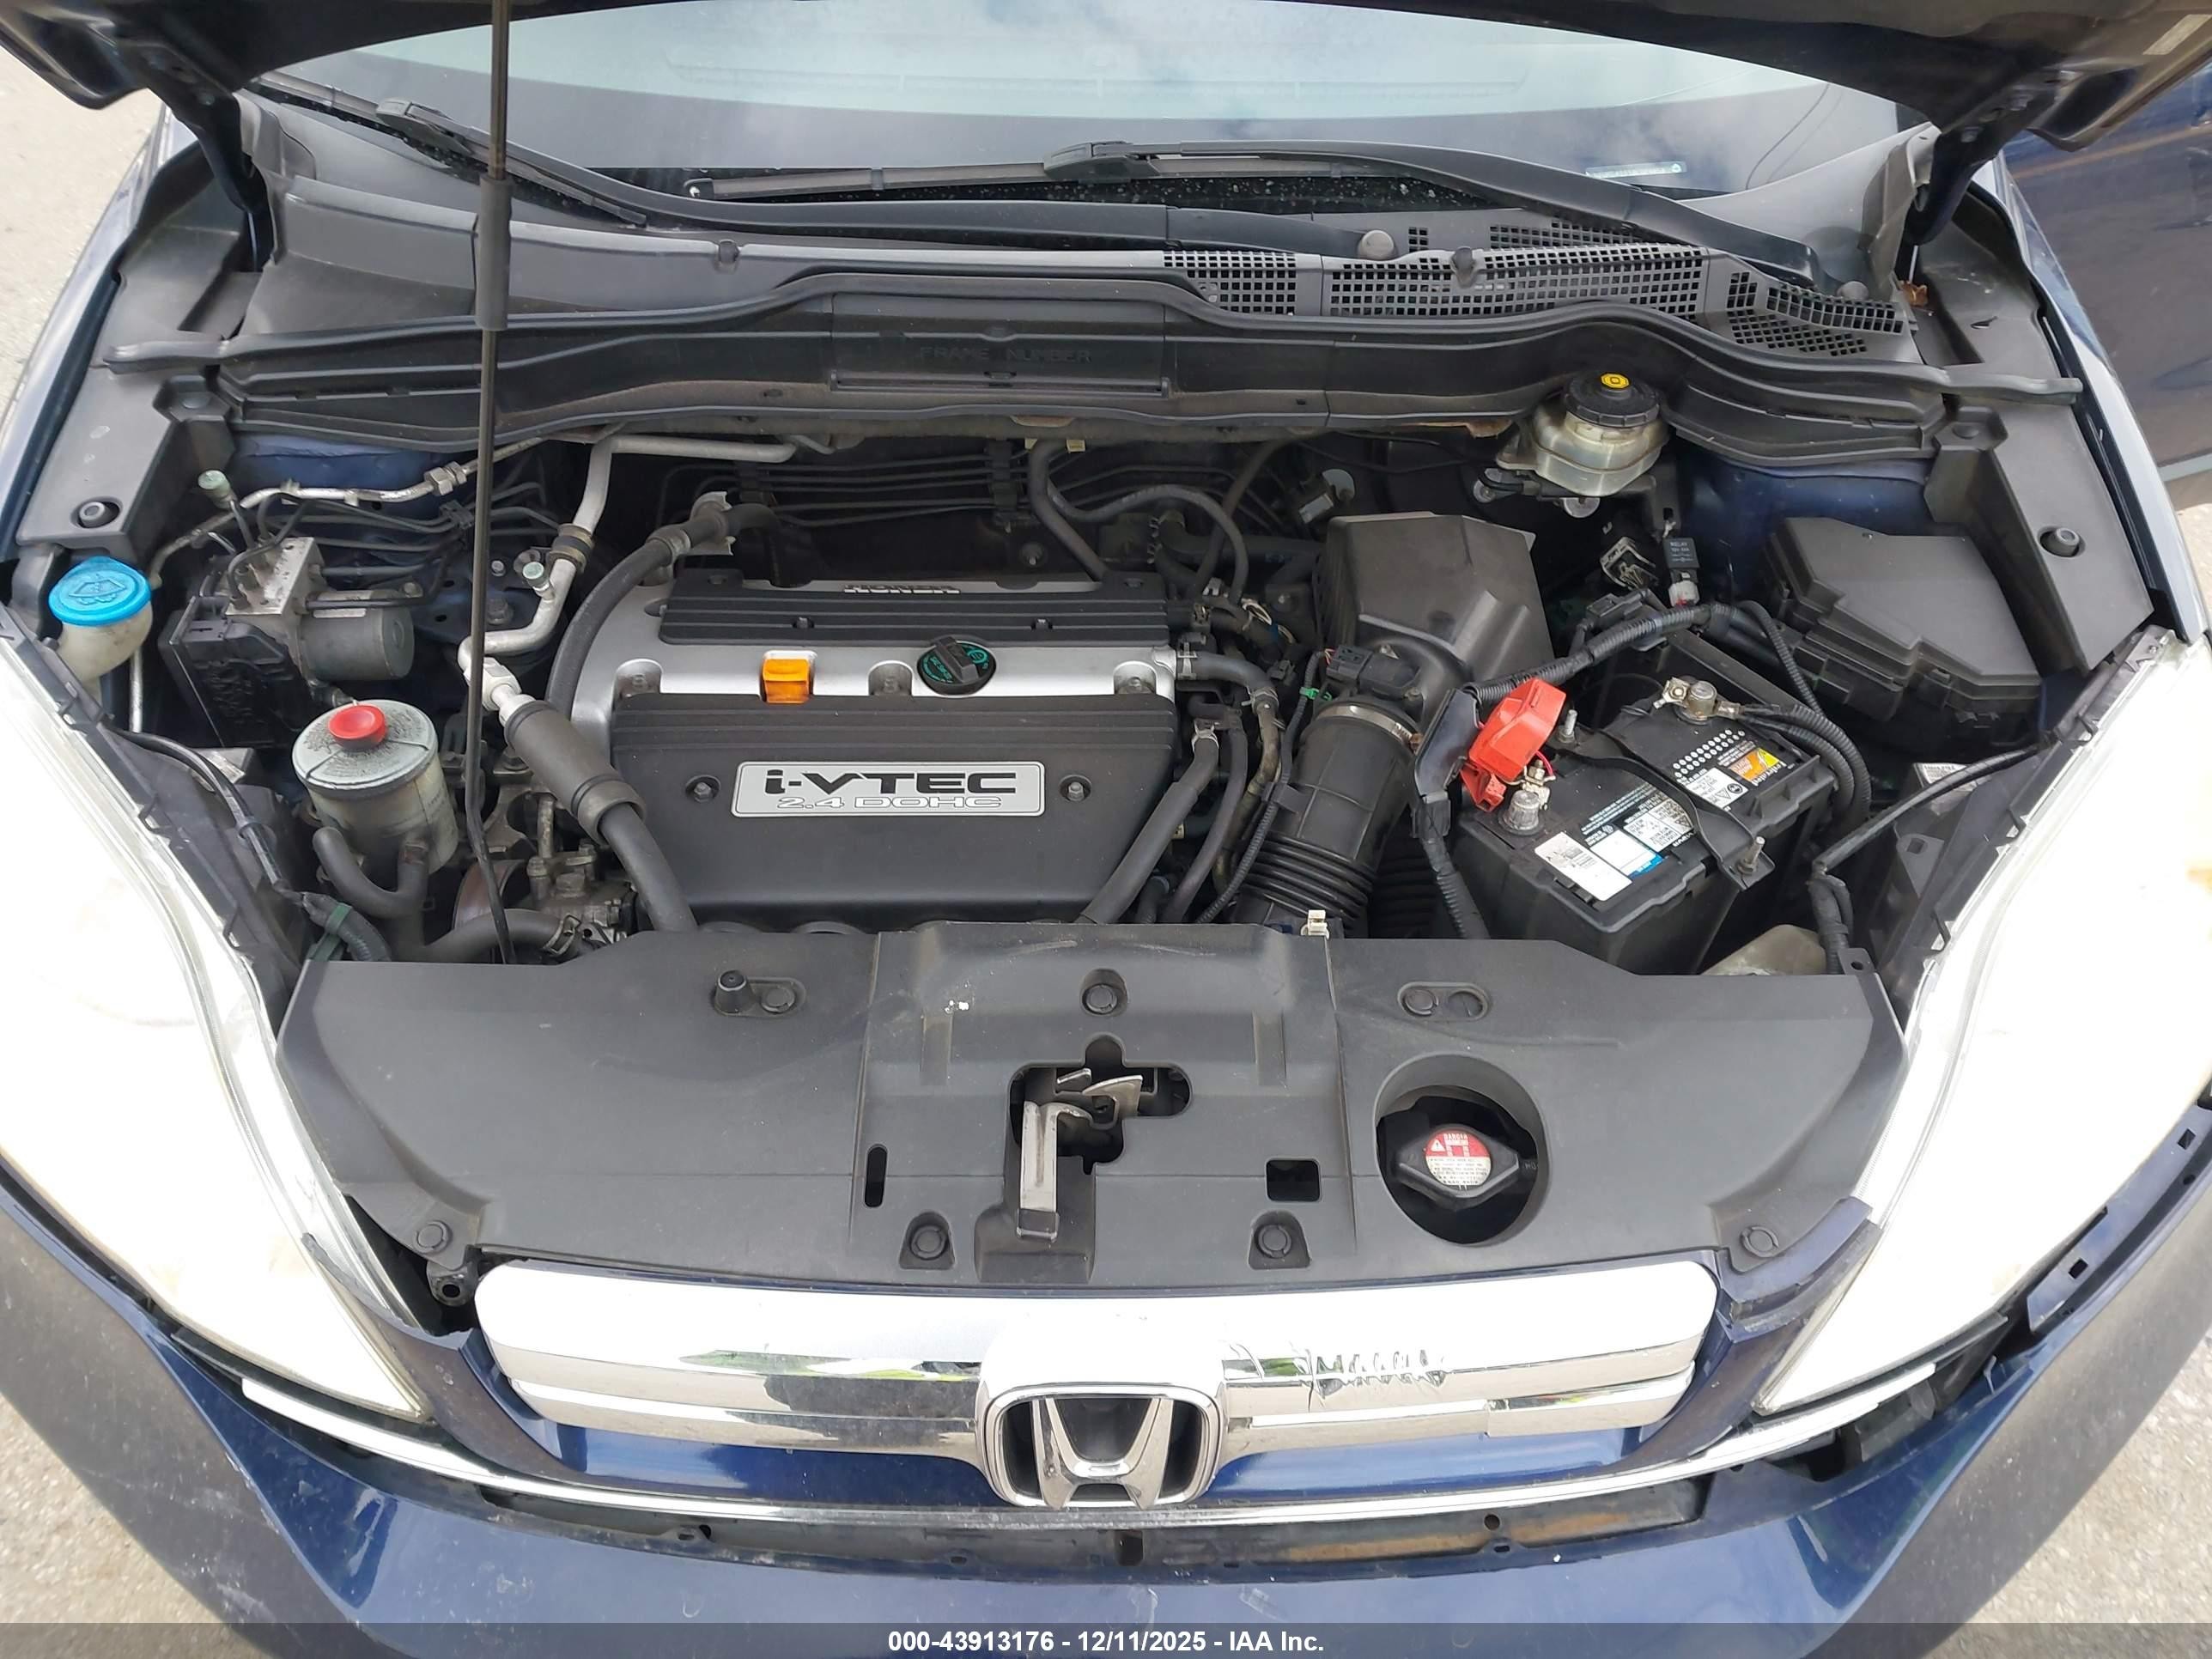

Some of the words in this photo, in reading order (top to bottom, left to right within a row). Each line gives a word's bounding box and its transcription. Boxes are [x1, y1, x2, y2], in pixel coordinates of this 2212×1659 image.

[921, 346, 990, 362] FRAME
[1008, 348, 1092, 363] NUMBER
[764, 769, 1017, 794] i-VTEC
[777, 797, 844, 809] 2.4
[854, 797, 1002, 809] DOHC
